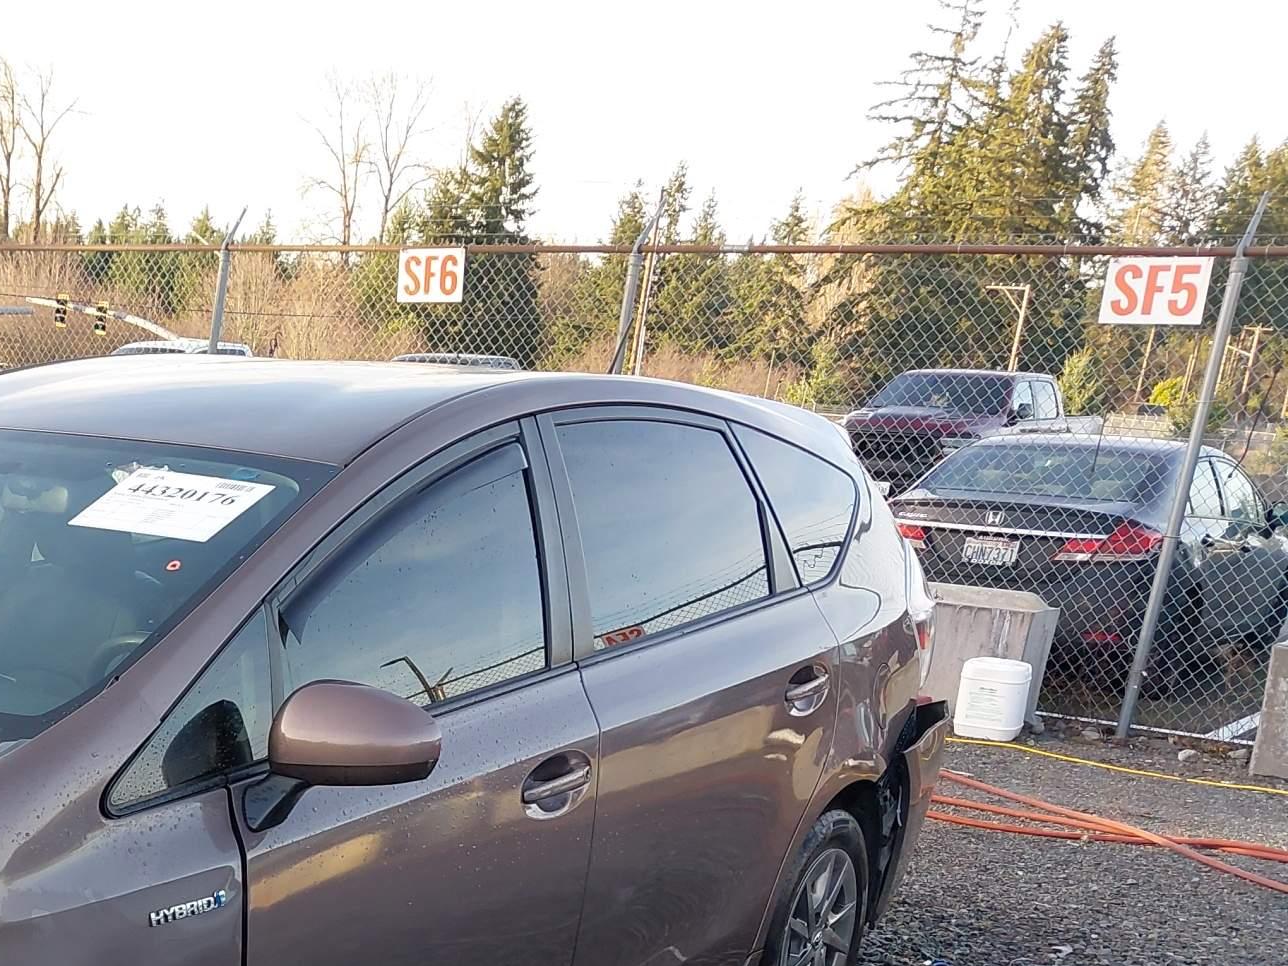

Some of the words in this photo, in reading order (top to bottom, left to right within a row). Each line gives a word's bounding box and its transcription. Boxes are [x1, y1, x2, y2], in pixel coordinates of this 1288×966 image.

[404, 255, 458, 295] SF6
[1110, 264, 1202, 316] SF5
[128, 483, 239, 505] 44320176
[964, 545, 1015, 562] CHN7371
[149, 896, 215, 927] HYBRID
